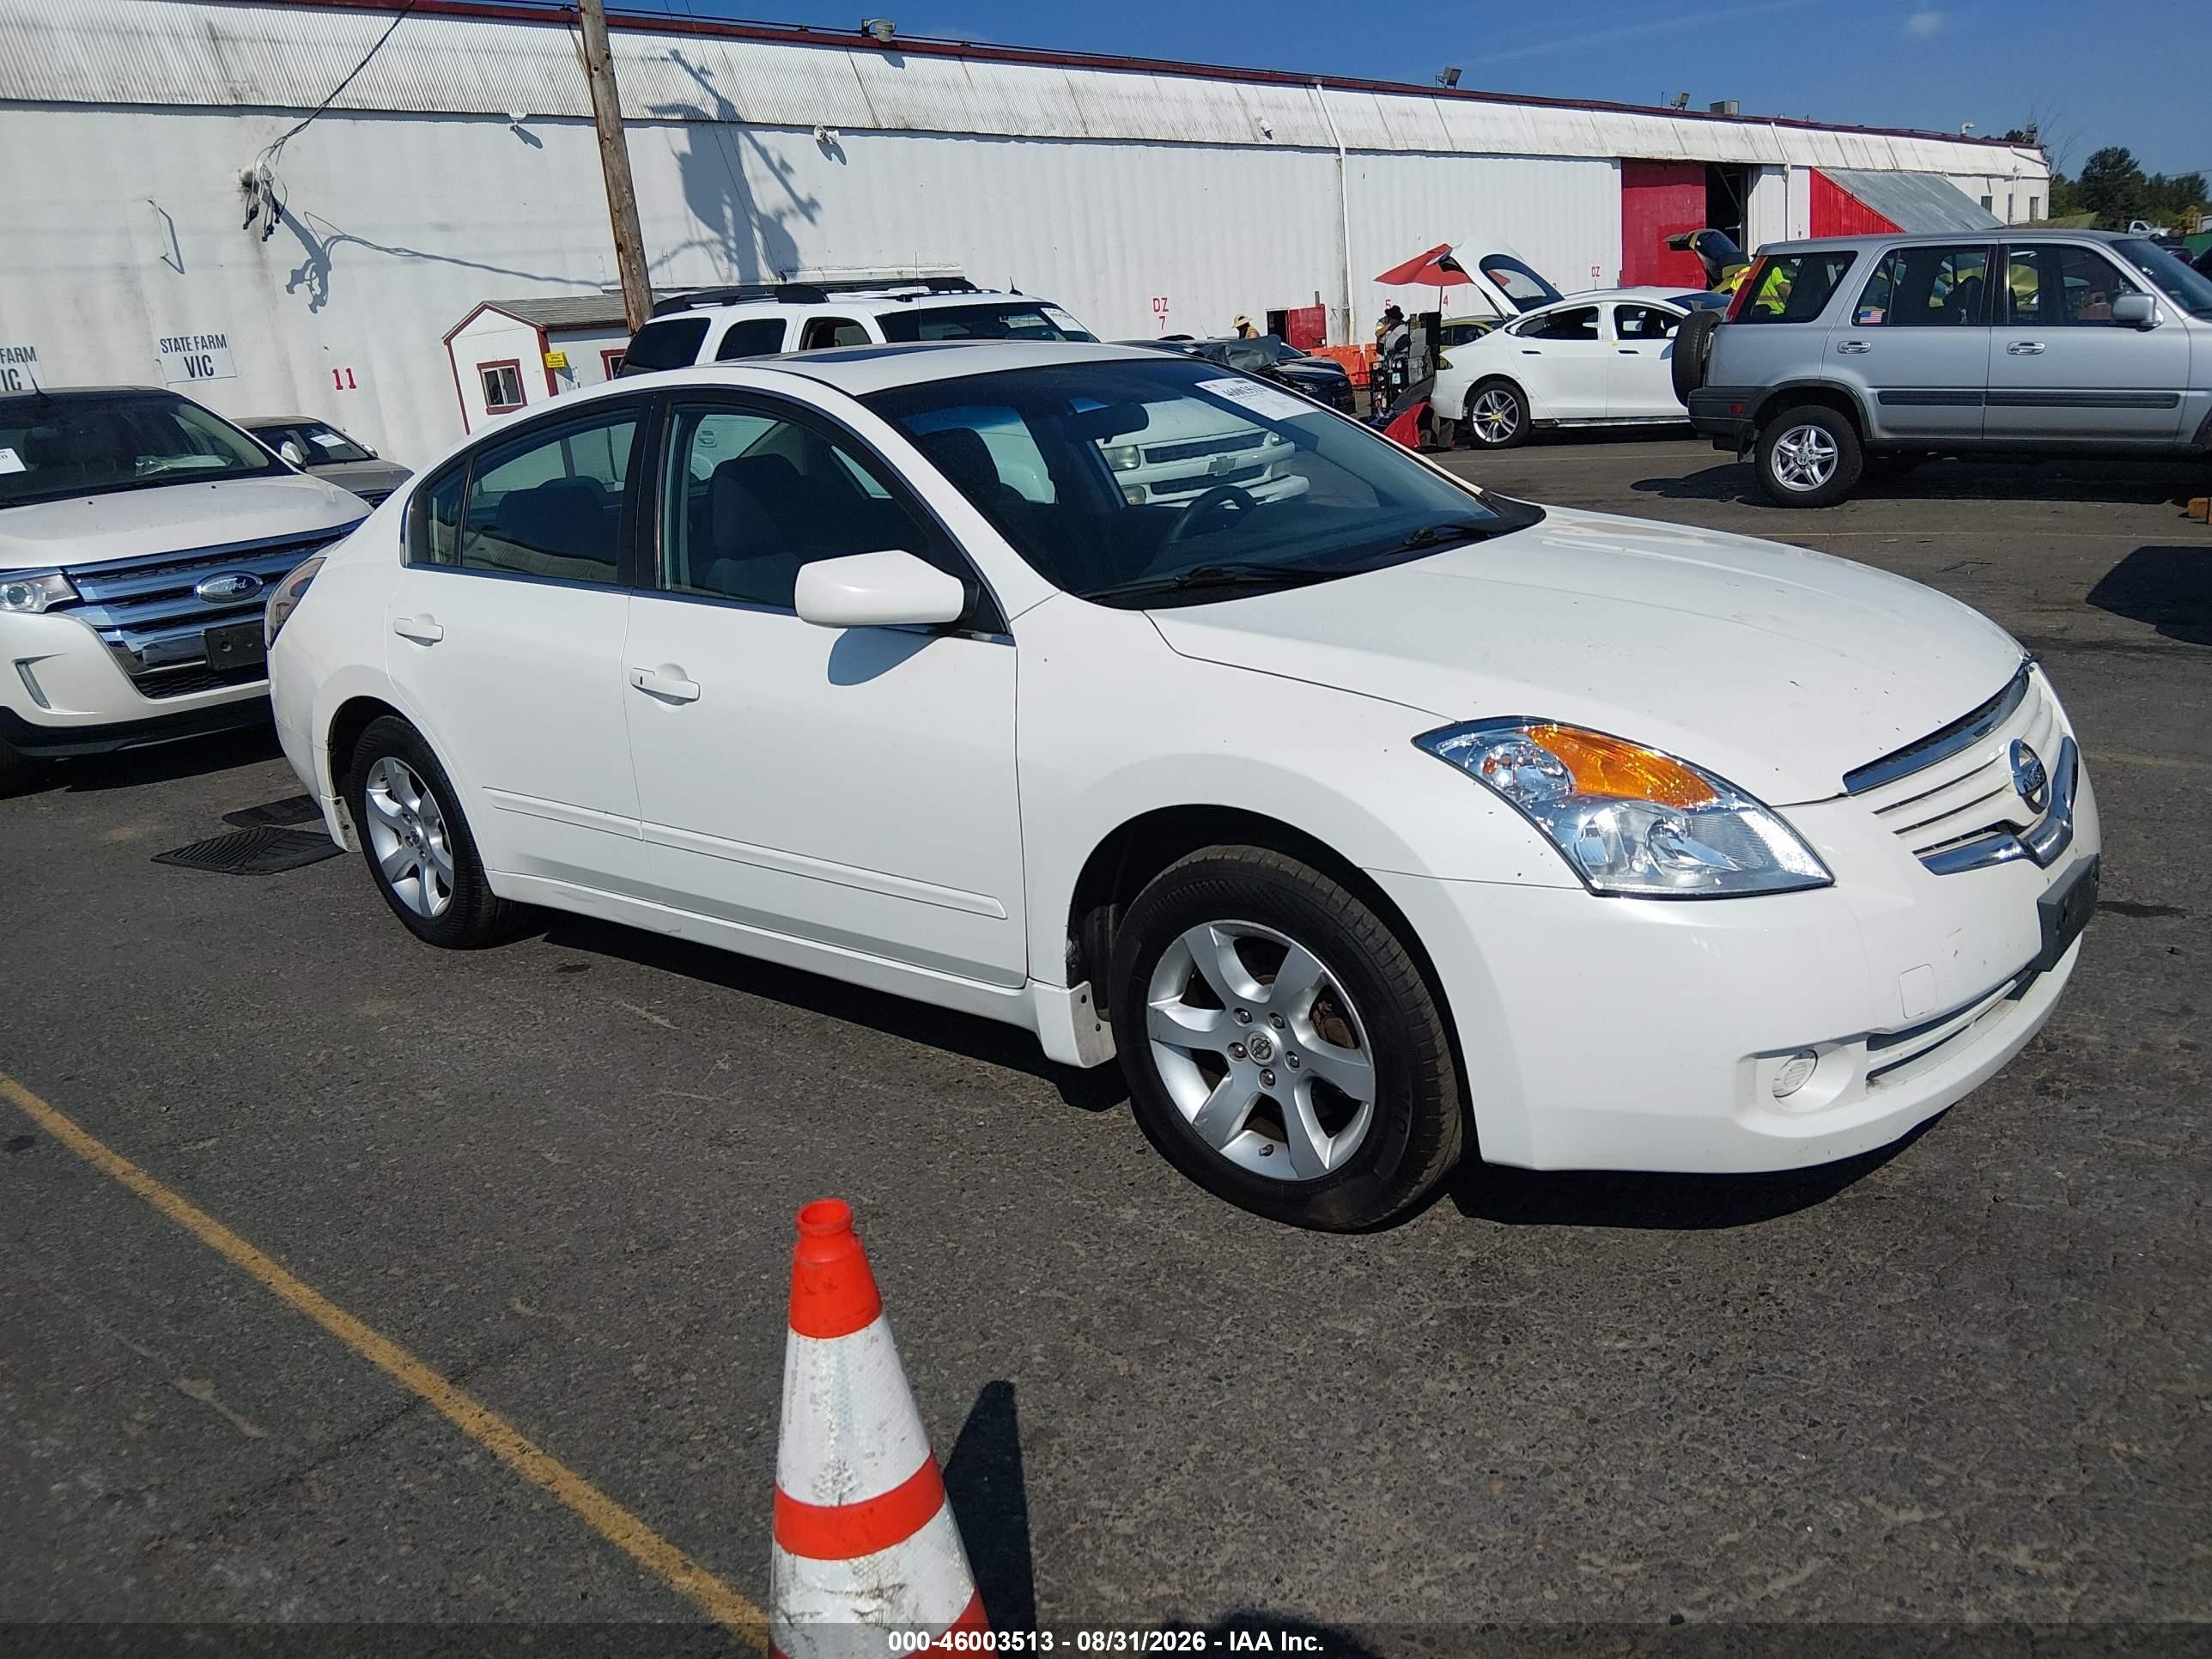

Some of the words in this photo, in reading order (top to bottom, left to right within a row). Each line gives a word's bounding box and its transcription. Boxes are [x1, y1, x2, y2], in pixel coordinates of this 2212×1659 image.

[1153, 297, 1169, 313] DZ
[1443, 295, 1449, 307] 4
[1159, 315, 1165, 331] 7
[160, 337, 192, 354] STATE
[193, 333, 228, 351] FARM
[0, 346, 37, 364] FARM
[183, 354, 214, 379] VIC
[0, 368, 21, 391] IC
[332, 368, 356, 391] 11
